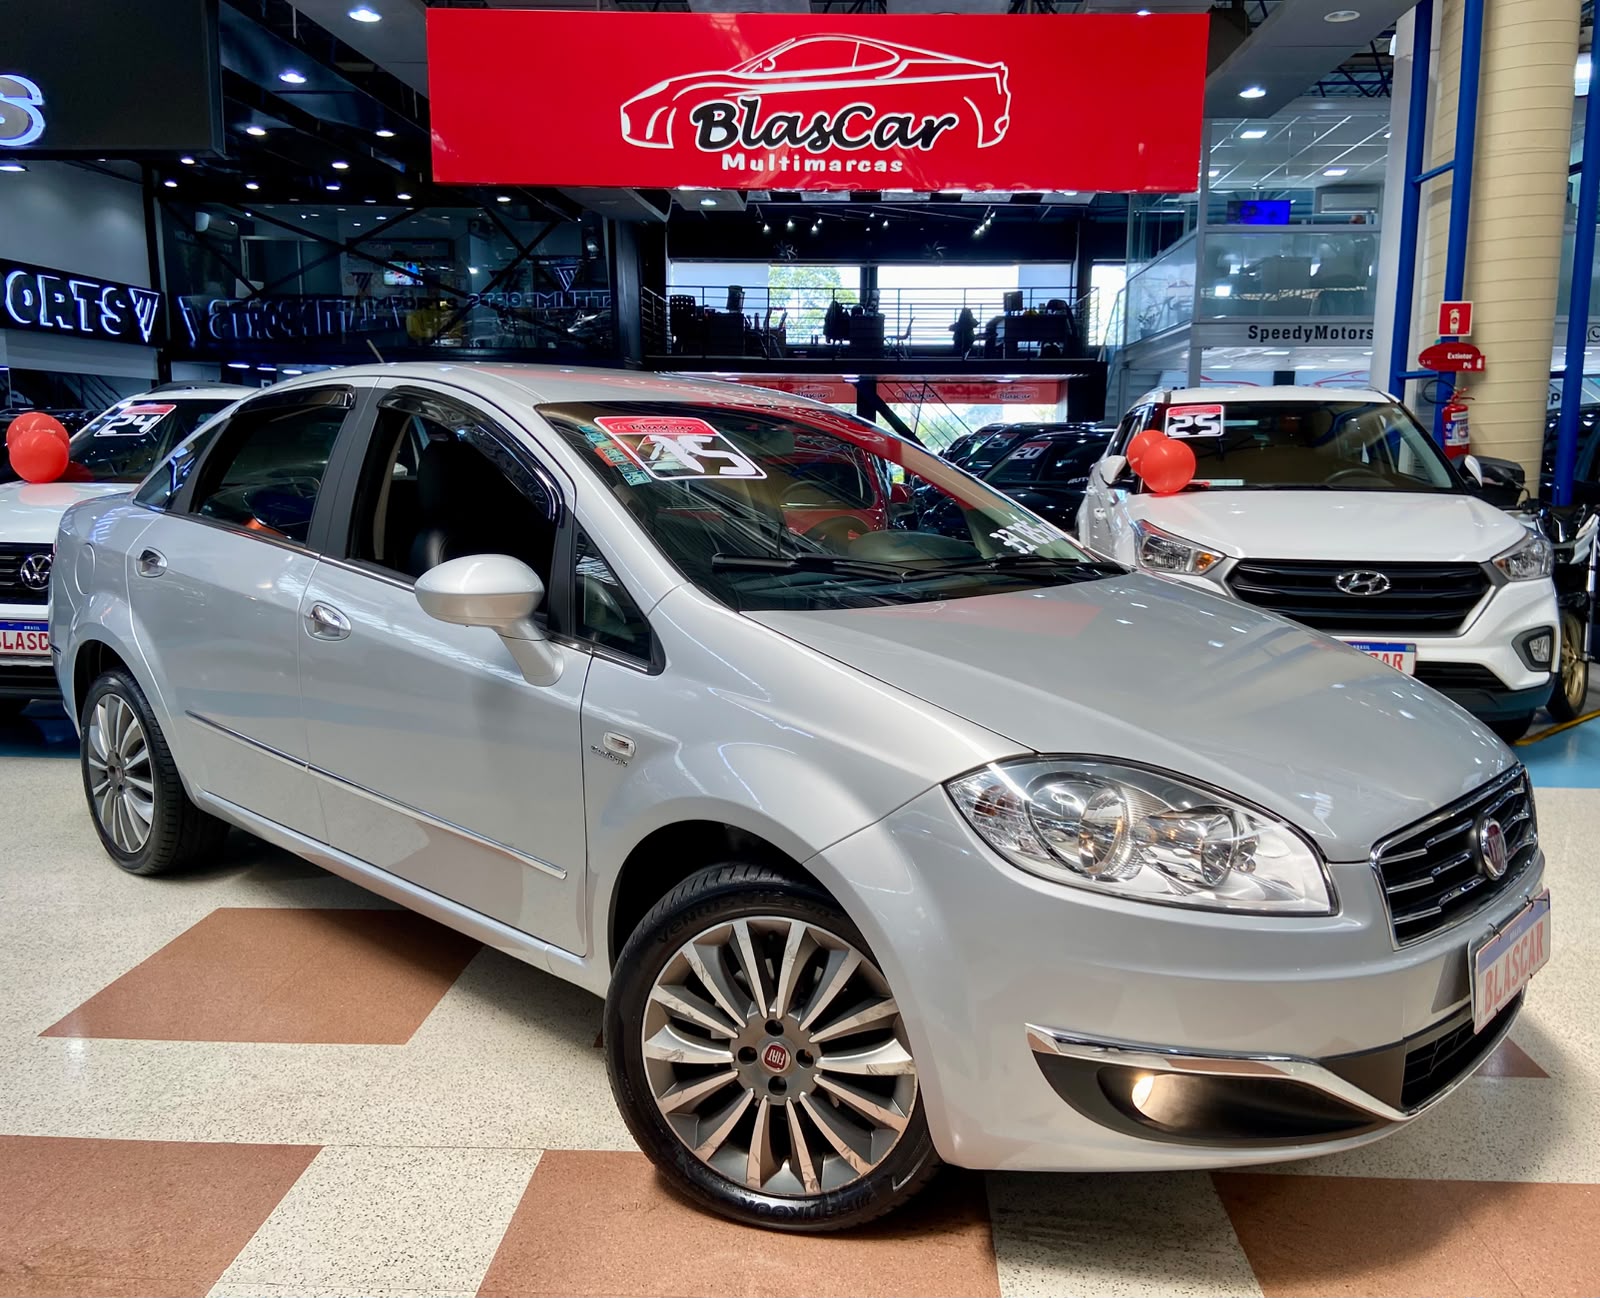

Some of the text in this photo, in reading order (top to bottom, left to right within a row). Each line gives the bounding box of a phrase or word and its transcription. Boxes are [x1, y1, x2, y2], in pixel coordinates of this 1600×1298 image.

[690, 95, 959, 154] BlasCar
[721, 153, 904, 173] Multimarcas
[1248, 325, 1374, 343] SpeedyMotors
[1447, 352, 1473, 360] Extintor
[100, 414, 161, 434] 24
[1167, 413, 1221, 438] 25
[0, 632, 49, 651] LASC
[1484, 920, 1544, 1017] BLASCAR
